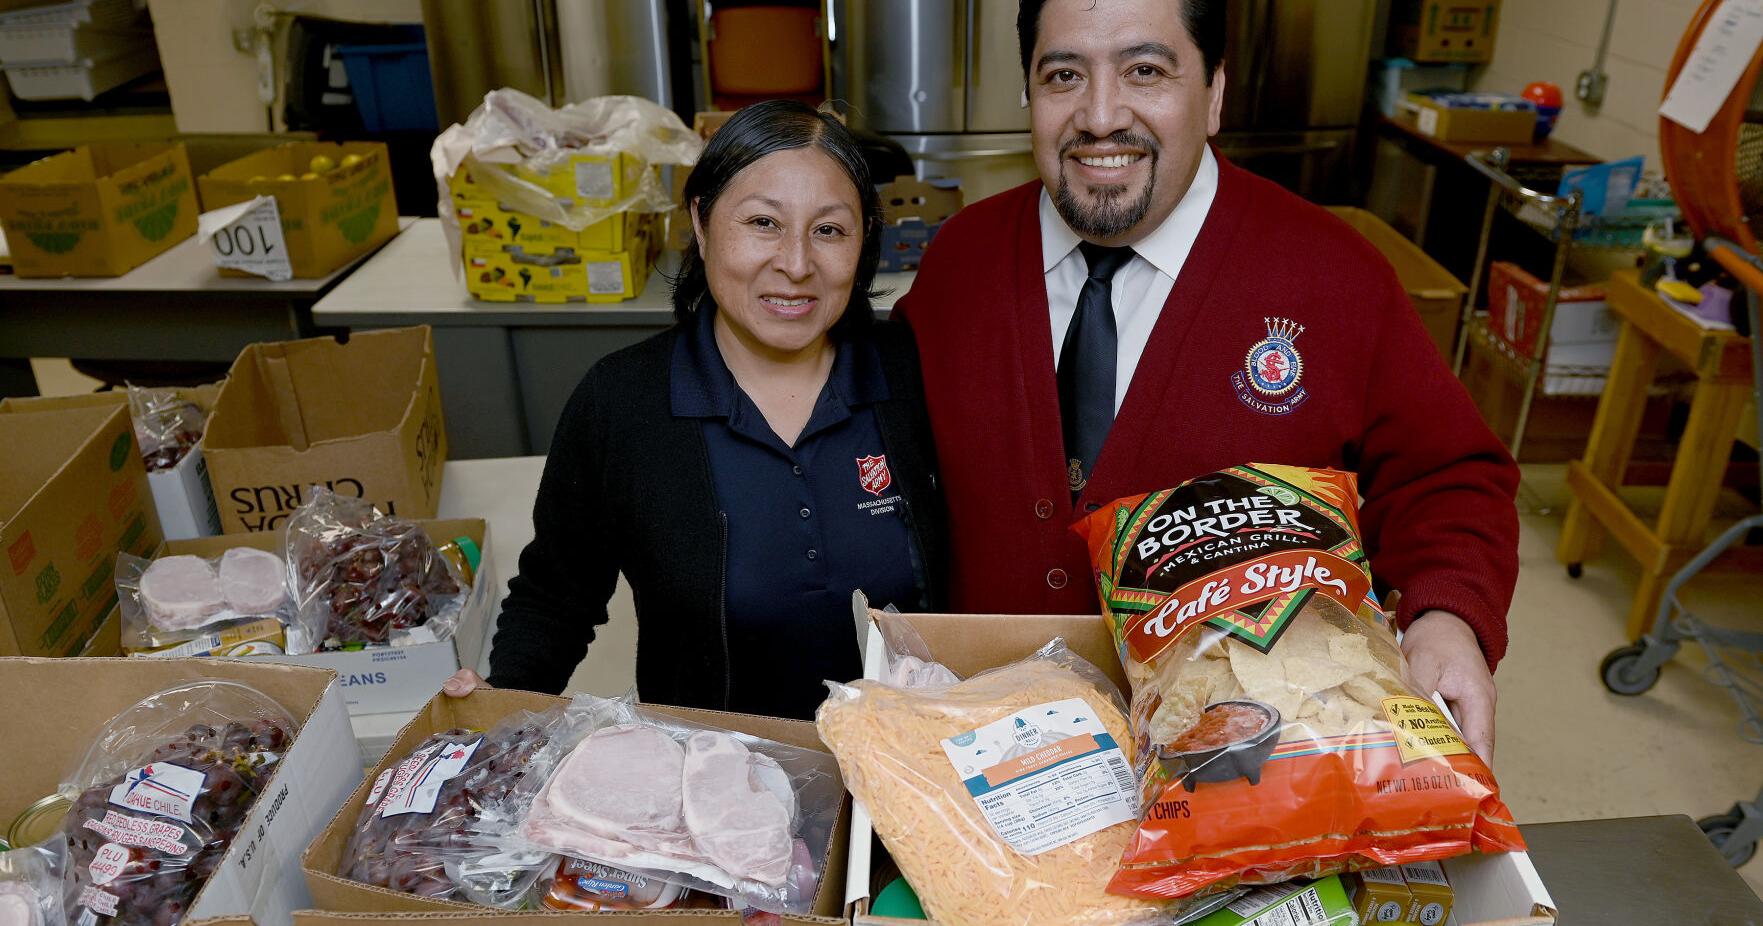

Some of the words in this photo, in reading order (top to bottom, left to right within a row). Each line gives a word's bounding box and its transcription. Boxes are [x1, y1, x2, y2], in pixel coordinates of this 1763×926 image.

[213, 225, 274, 256] 100
[1250, 345, 1269, 367] BLOOD
[1275, 345, 1292, 357] AND
[1233, 375, 1244, 390] THE
[1241, 393, 1290, 413] SALVATION
[1290, 389, 1306, 405] ARMY
[861, 459, 885, 487] SALVATION
[862, 459, 874, 473] THE
[871, 469, 886, 491] ARMY
[857, 494, 902, 510] MASSACHUSETTS
[870, 505, 895, 516] DIVISION
[1147, 505, 1197, 533] ON
[1203, 496, 1275, 514] THE
[1137, 509, 1316, 560] BORDER
[1163, 536, 1242, 573] MEXICAN
[1249, 534, 1300, 544] GRILL
[1190, 557, 1200, 565] &
[1203, 541, 1270, 560] CANTINA
[1143, 578, 1231, 638] Café
[1240, 556, 1347, 597] Style
[1409, 718, 1426, 730] NO
[1015, 728, 1039, 742] DINNER
[1418, 736, 1446, 746] Gluten
[1020, 756, 1035, 766] MILD
[1035, 746, 1062, 762] CHEDDAR
[1376, 780, 1392, 794] NET
[1392, 778, 1410, 793] WT.
[1431, 776, 1442, 790] OZ
[153, 801, 182, 816] CHILE
[265, 783, 289, 827] PRODUCE
[981, 792, 1012, 806] Nutrition
[984, 801, 1005, 811] Facts
[1154, 800, 1191, 820] CHIPS
[149, 820, 182, 840] GRAPES
[994, 816, 1012, 826] Serving
[1001, 827, 1021, 836] Calories
[1022, 823, 1036, 832] 110
[257, 825, 265, 842] OF
[101, 848, 123, 861] PLU
[155, 838, 185, 855] PEPINS
[238, 841, 257, 869] U.S.A.
[570, 859, 610, 878] Sweet
[583, 879, 601, 888] Ripe
[599, 882, 625, 892] Garden
[1288, 900, 1301, 922] Calories
[1307, 888, 1326, 922] Nutritio
